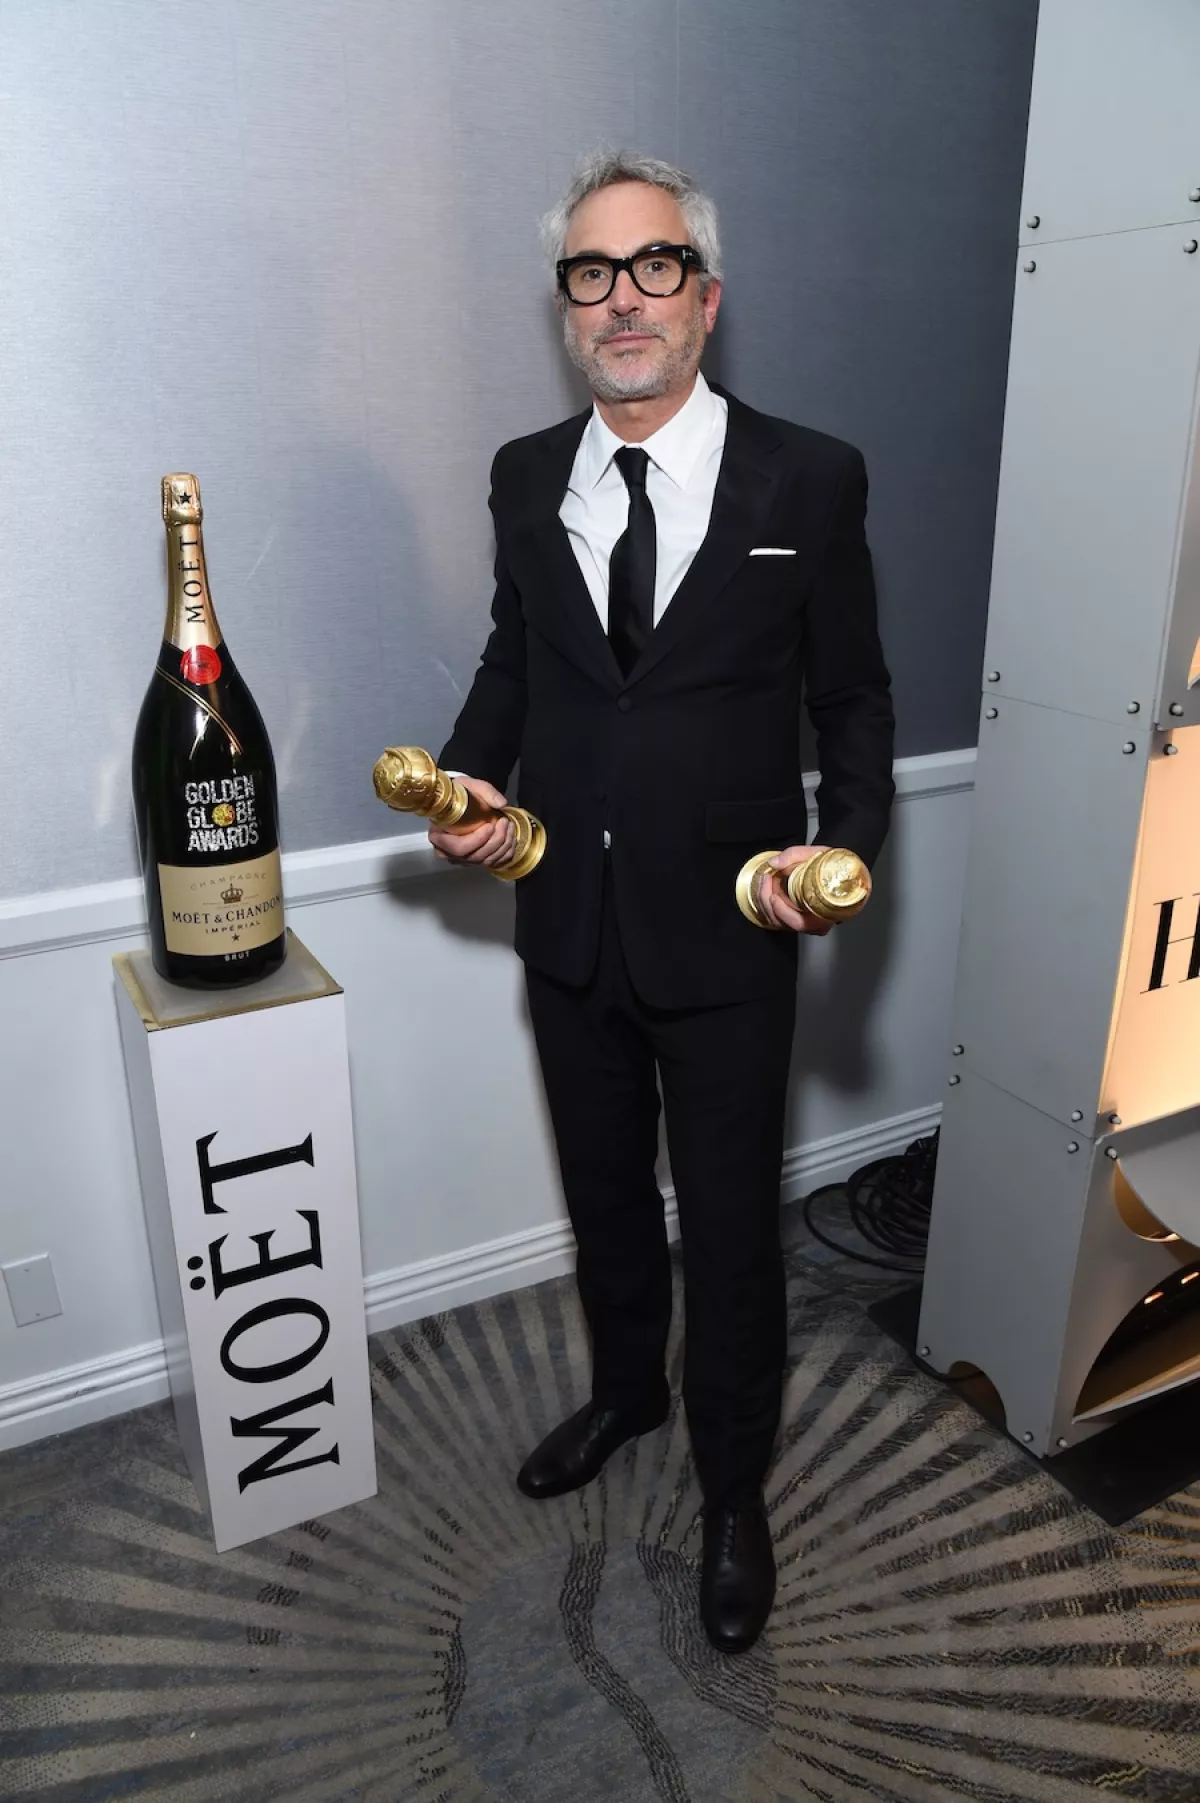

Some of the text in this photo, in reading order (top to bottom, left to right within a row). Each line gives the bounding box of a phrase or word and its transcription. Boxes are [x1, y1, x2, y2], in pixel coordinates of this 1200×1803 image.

[178, 535, 206, 624] MOËT
[185, 774, 255, 804] GOLDEN
[187, 822, 259, 851] AWARDS
[190, 872, 267, 891] CHAMPAGNE
[172, 911, 211, 924] MOËT
[214, 914, 222, 924] &
[224, 951, 250, 962] BRUT
[187, 1131, 340, 1494] MOËT
